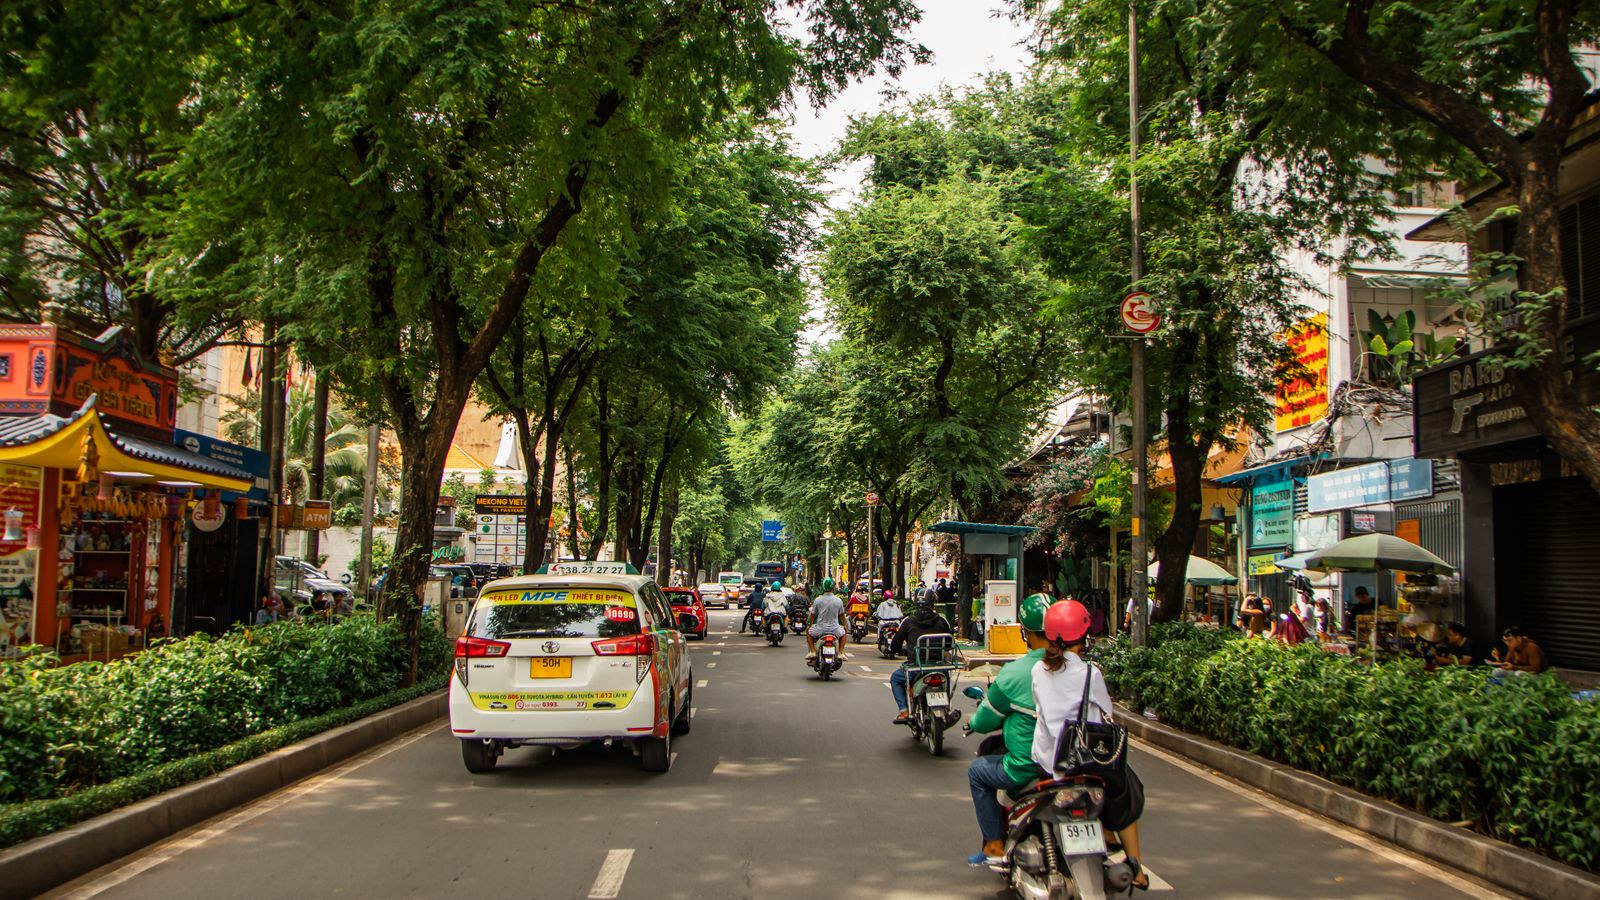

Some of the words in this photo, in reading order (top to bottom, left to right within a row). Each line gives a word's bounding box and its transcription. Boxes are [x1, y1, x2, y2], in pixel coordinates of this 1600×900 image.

[476, 497, 508, 506] MEKONG
[306, 513, 328, 522] ATM
[611, 566, 624, 574] 27
[504, 593, 519, 601] LED
[520, 591, 570, 602] MPE
[571, 591, 593, 600] THIẾT
[607, 609, 634, 620] 10690
[542, 658, 561, 668] 50H
[1066, 823, 1097, 838] 59-Y1
